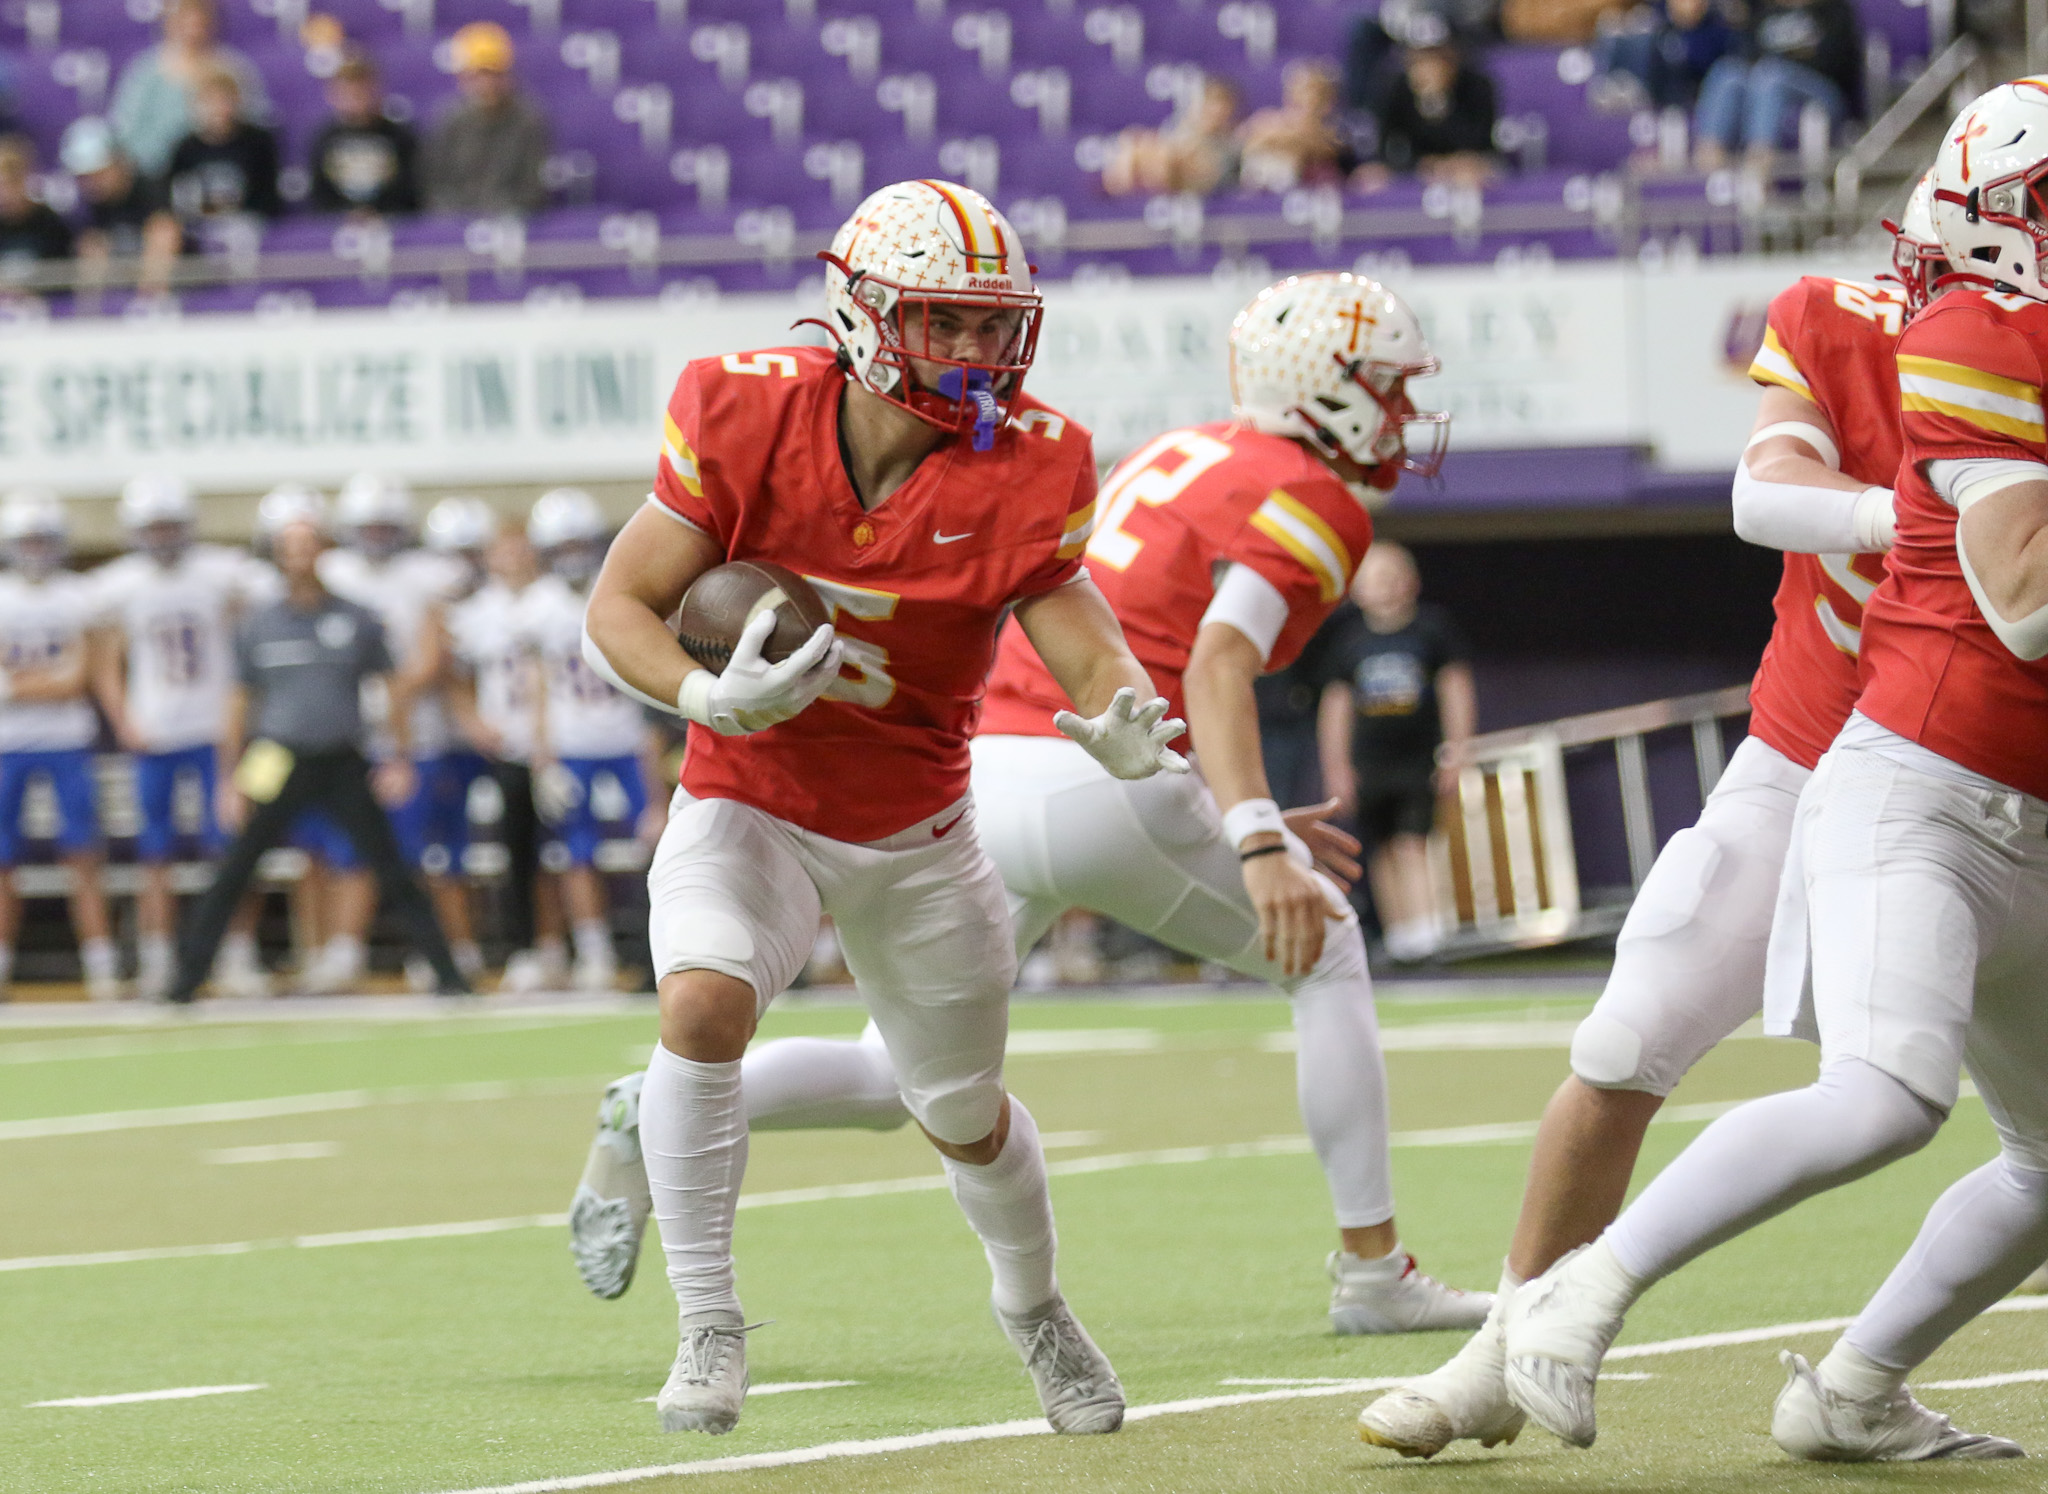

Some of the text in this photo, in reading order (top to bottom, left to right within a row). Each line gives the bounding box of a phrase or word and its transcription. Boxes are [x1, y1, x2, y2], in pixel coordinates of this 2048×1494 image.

[968, 276, 1012, 290] Riddell
[721, 352, 799, 378] 5
[443, 346, 516, 436] IN
